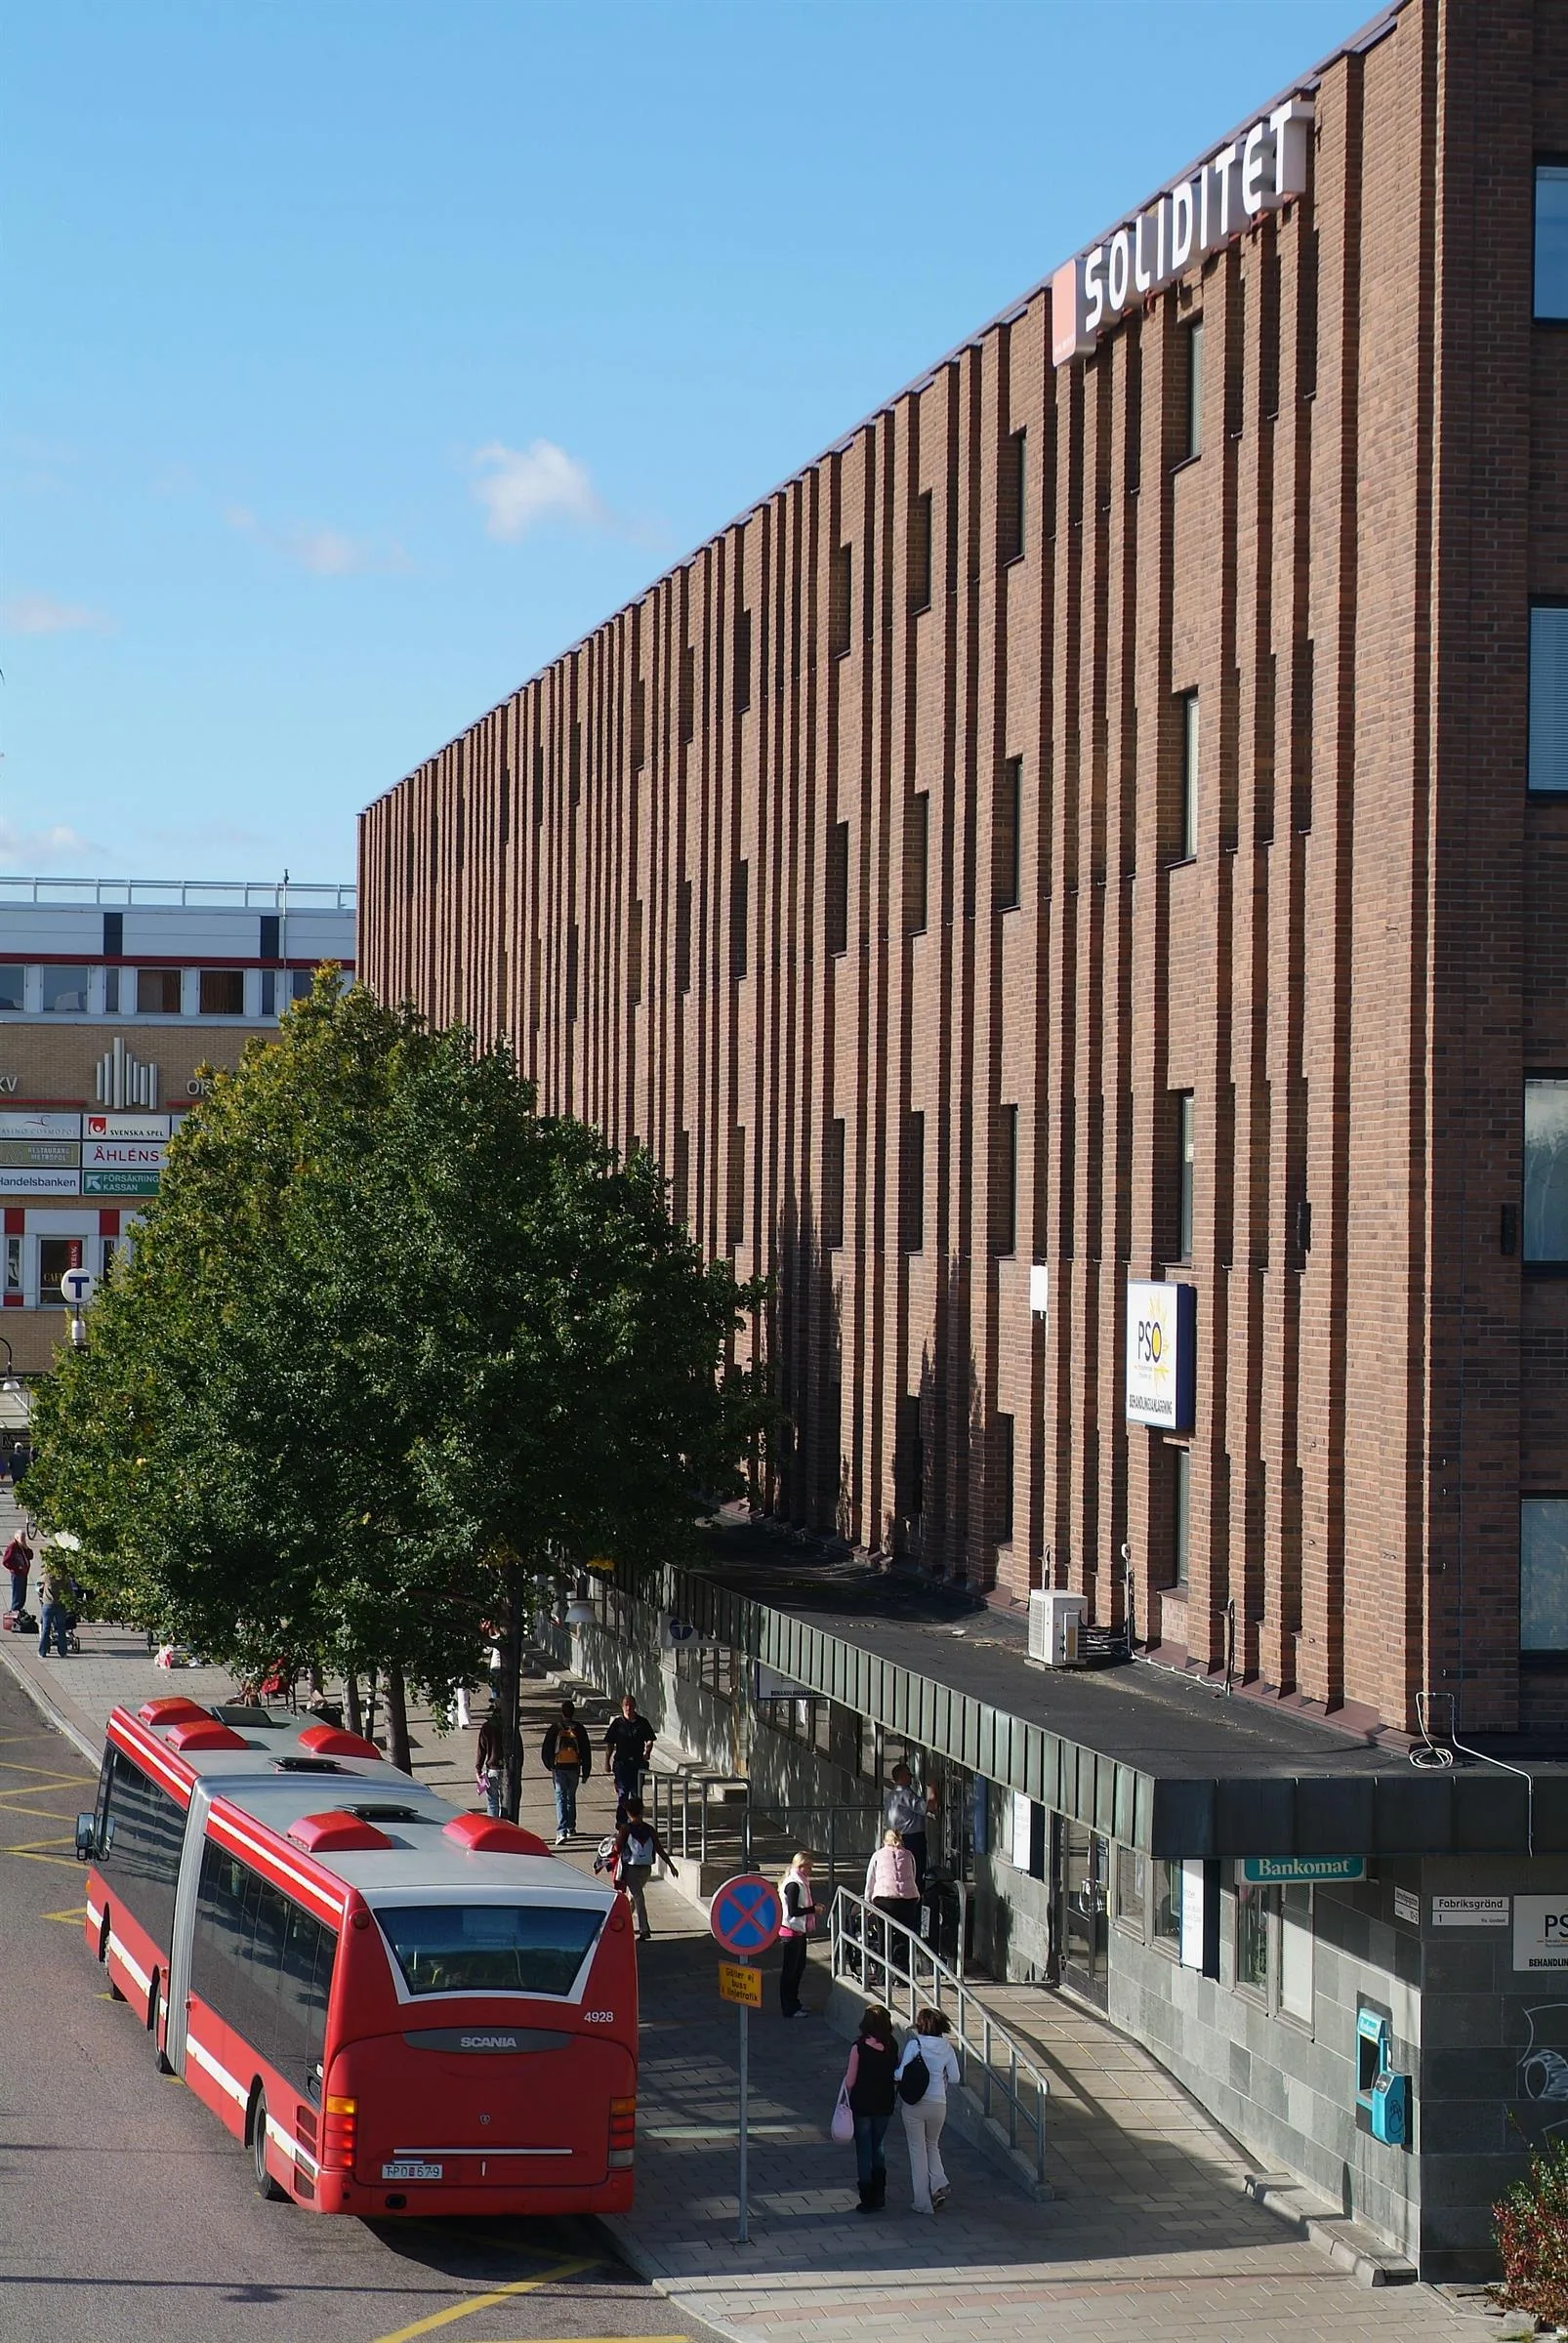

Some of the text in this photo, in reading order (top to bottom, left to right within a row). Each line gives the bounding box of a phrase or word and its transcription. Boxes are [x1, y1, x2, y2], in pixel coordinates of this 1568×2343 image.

[1084, 100, 1294, 333] SOLIDITET
[94, 1145, 159, 1162] ÅHLÉNS
[1137, 1320, 1163, 1364] PSO
[1259, 1858, 1350, 1876] Bankomat
[1439, 1899, 1504, 1911] Fabriksgränd
[584, 2011, 614, 2023] 4928
[460, 2036, 517, 2048] SCANIA
